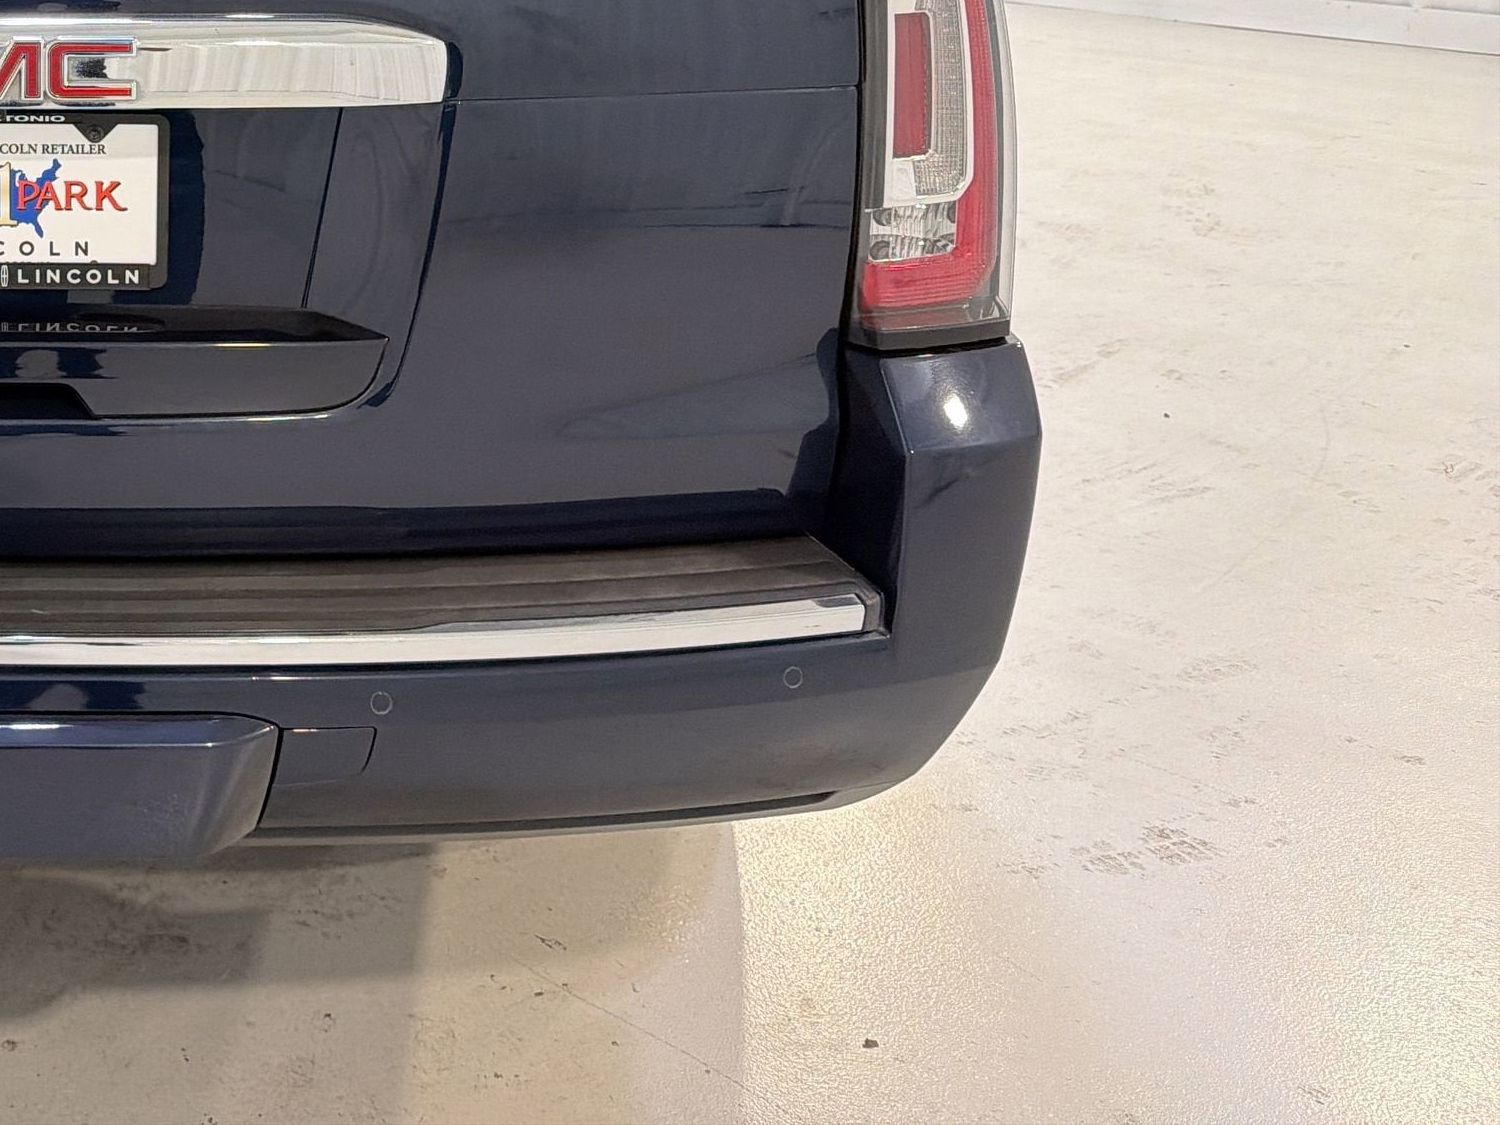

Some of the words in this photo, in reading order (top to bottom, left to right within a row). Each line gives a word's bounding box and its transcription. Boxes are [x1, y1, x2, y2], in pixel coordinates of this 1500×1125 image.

[41, 143, 107, 155] RETAILER
[16, 179, 129, 212] PARK
[17, 268, 140, 285] LINCOLN
